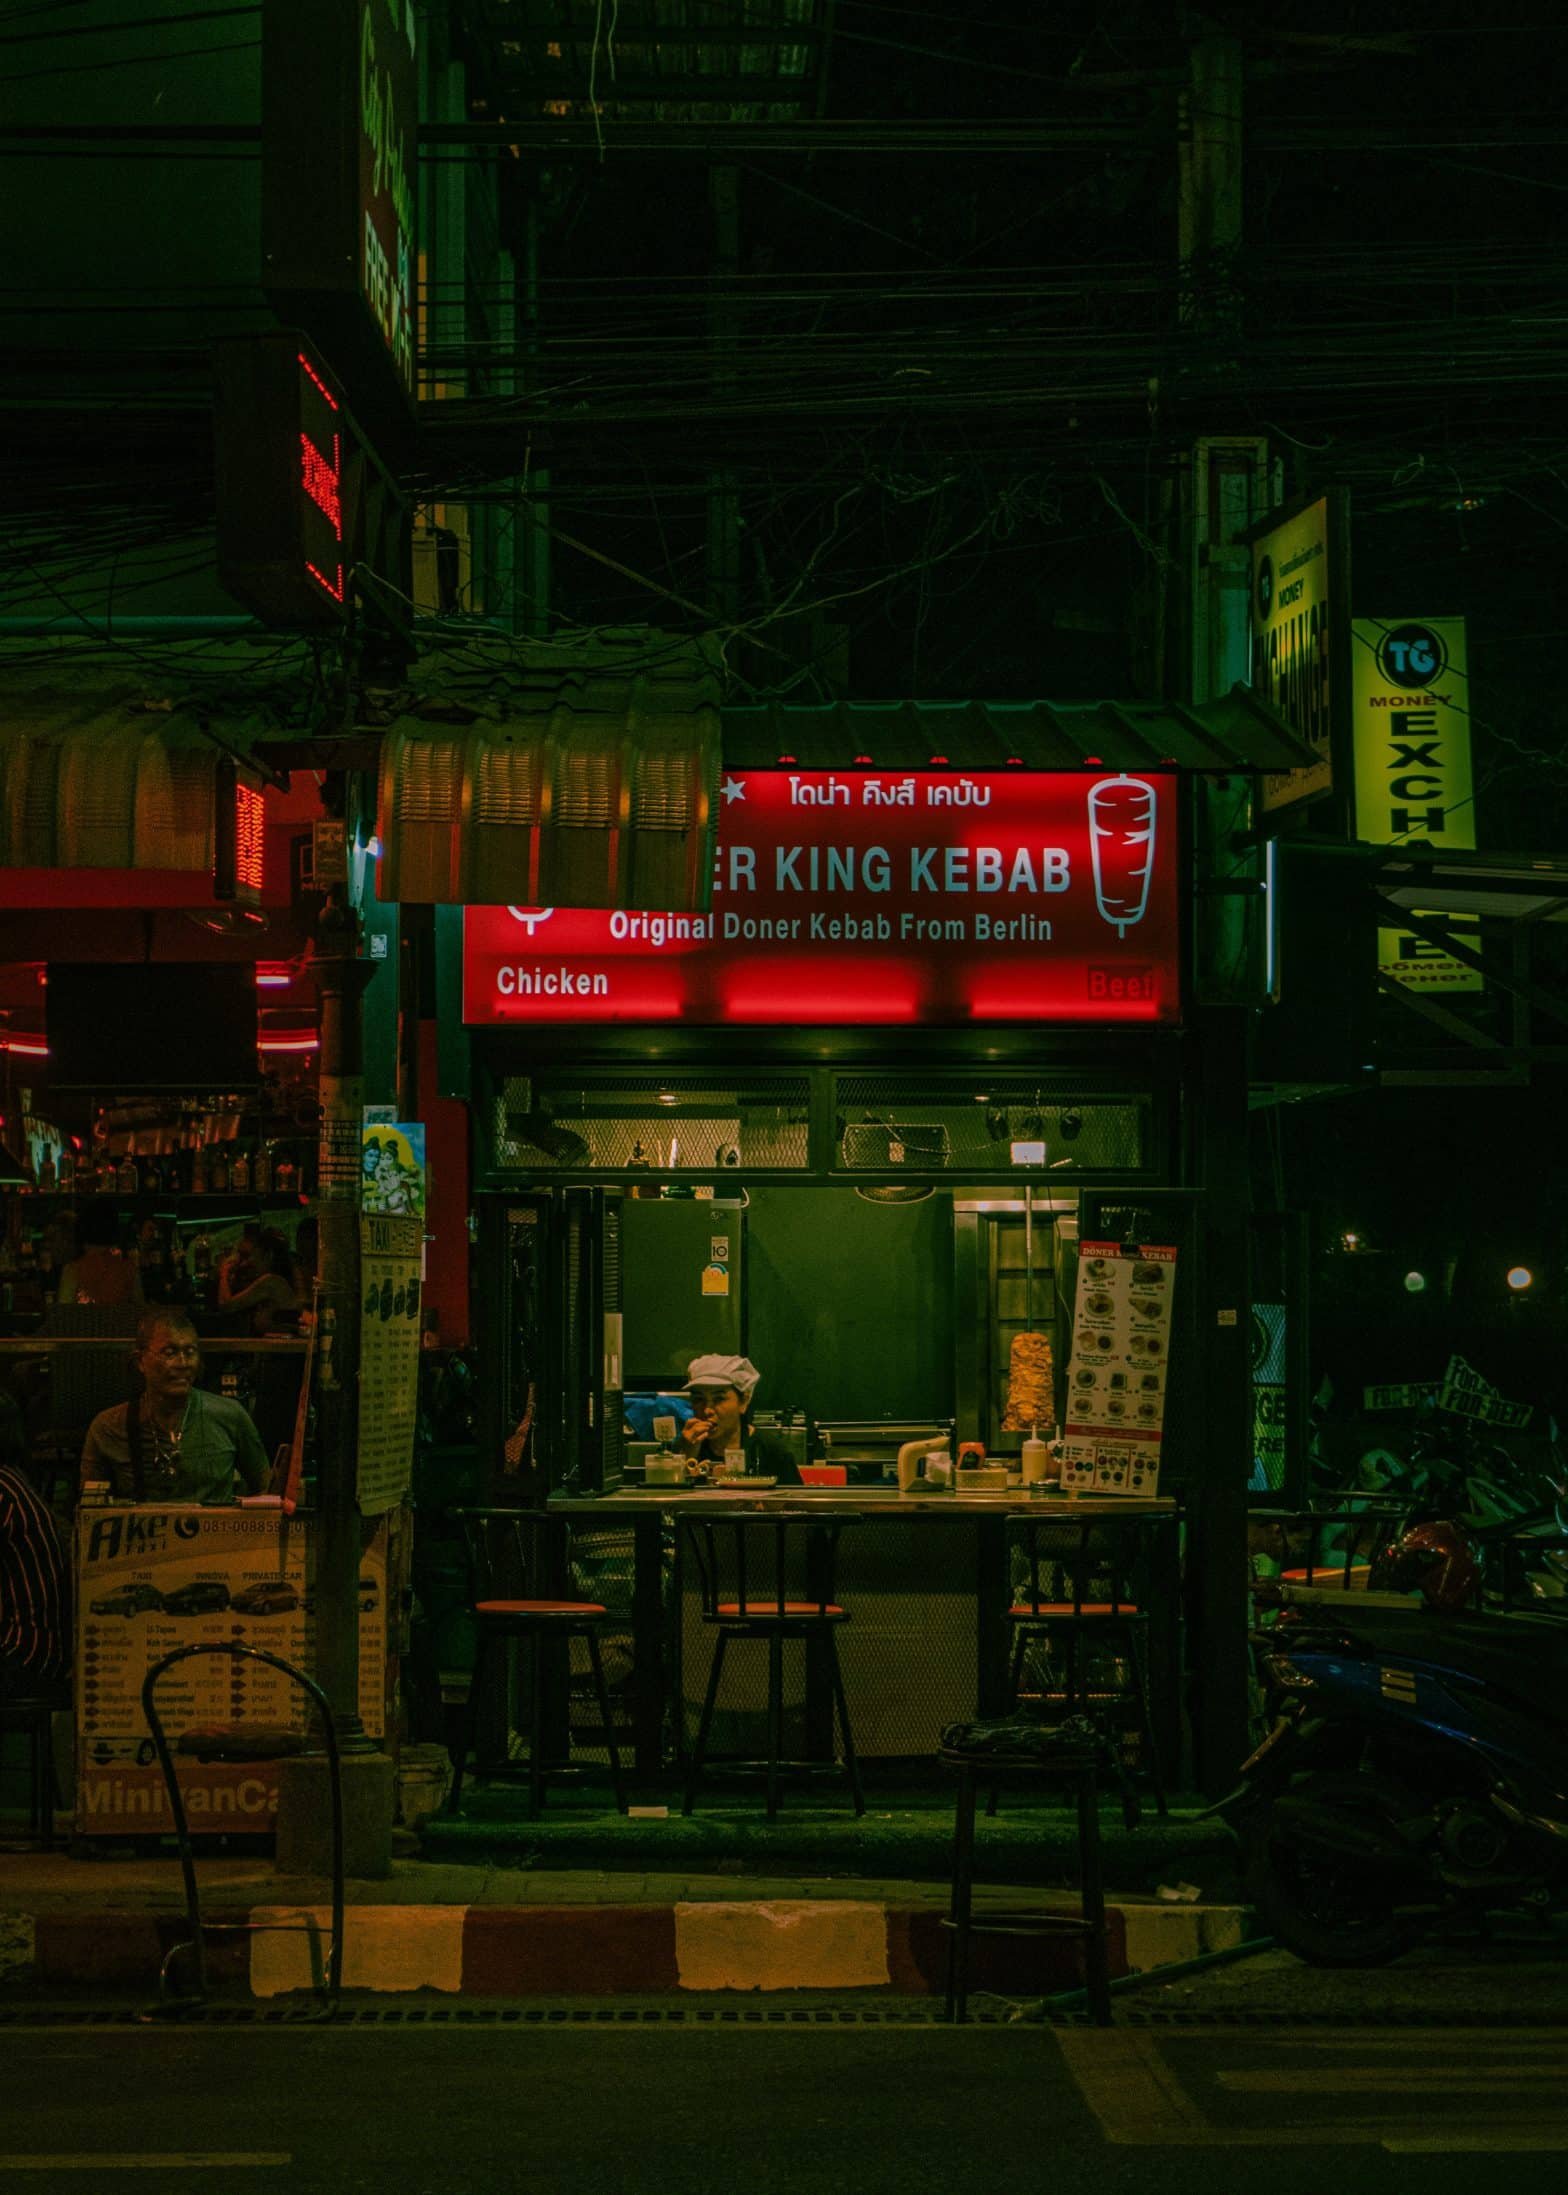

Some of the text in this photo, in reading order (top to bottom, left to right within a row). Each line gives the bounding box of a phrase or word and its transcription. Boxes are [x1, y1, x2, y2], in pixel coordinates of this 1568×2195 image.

[1278, 577, 1304, 611] MONEY
[1388, 639, 1436, 674] TG
[1369, 695, 1452, 707] MONEY
[788, 776, 990, 807] โดน่า คิงส์ เคบับ
[775, 845, 892, 893] KING
[911, 847, 1071, 892] KEBAB
[609, 910, 1051, 946] Original Doner Kebab From Berlin
[497, 966, 608, 995] Chicken
[1090, 968, 1153, 999] Beef
[369, 1222, 392, 1252] TAXI
